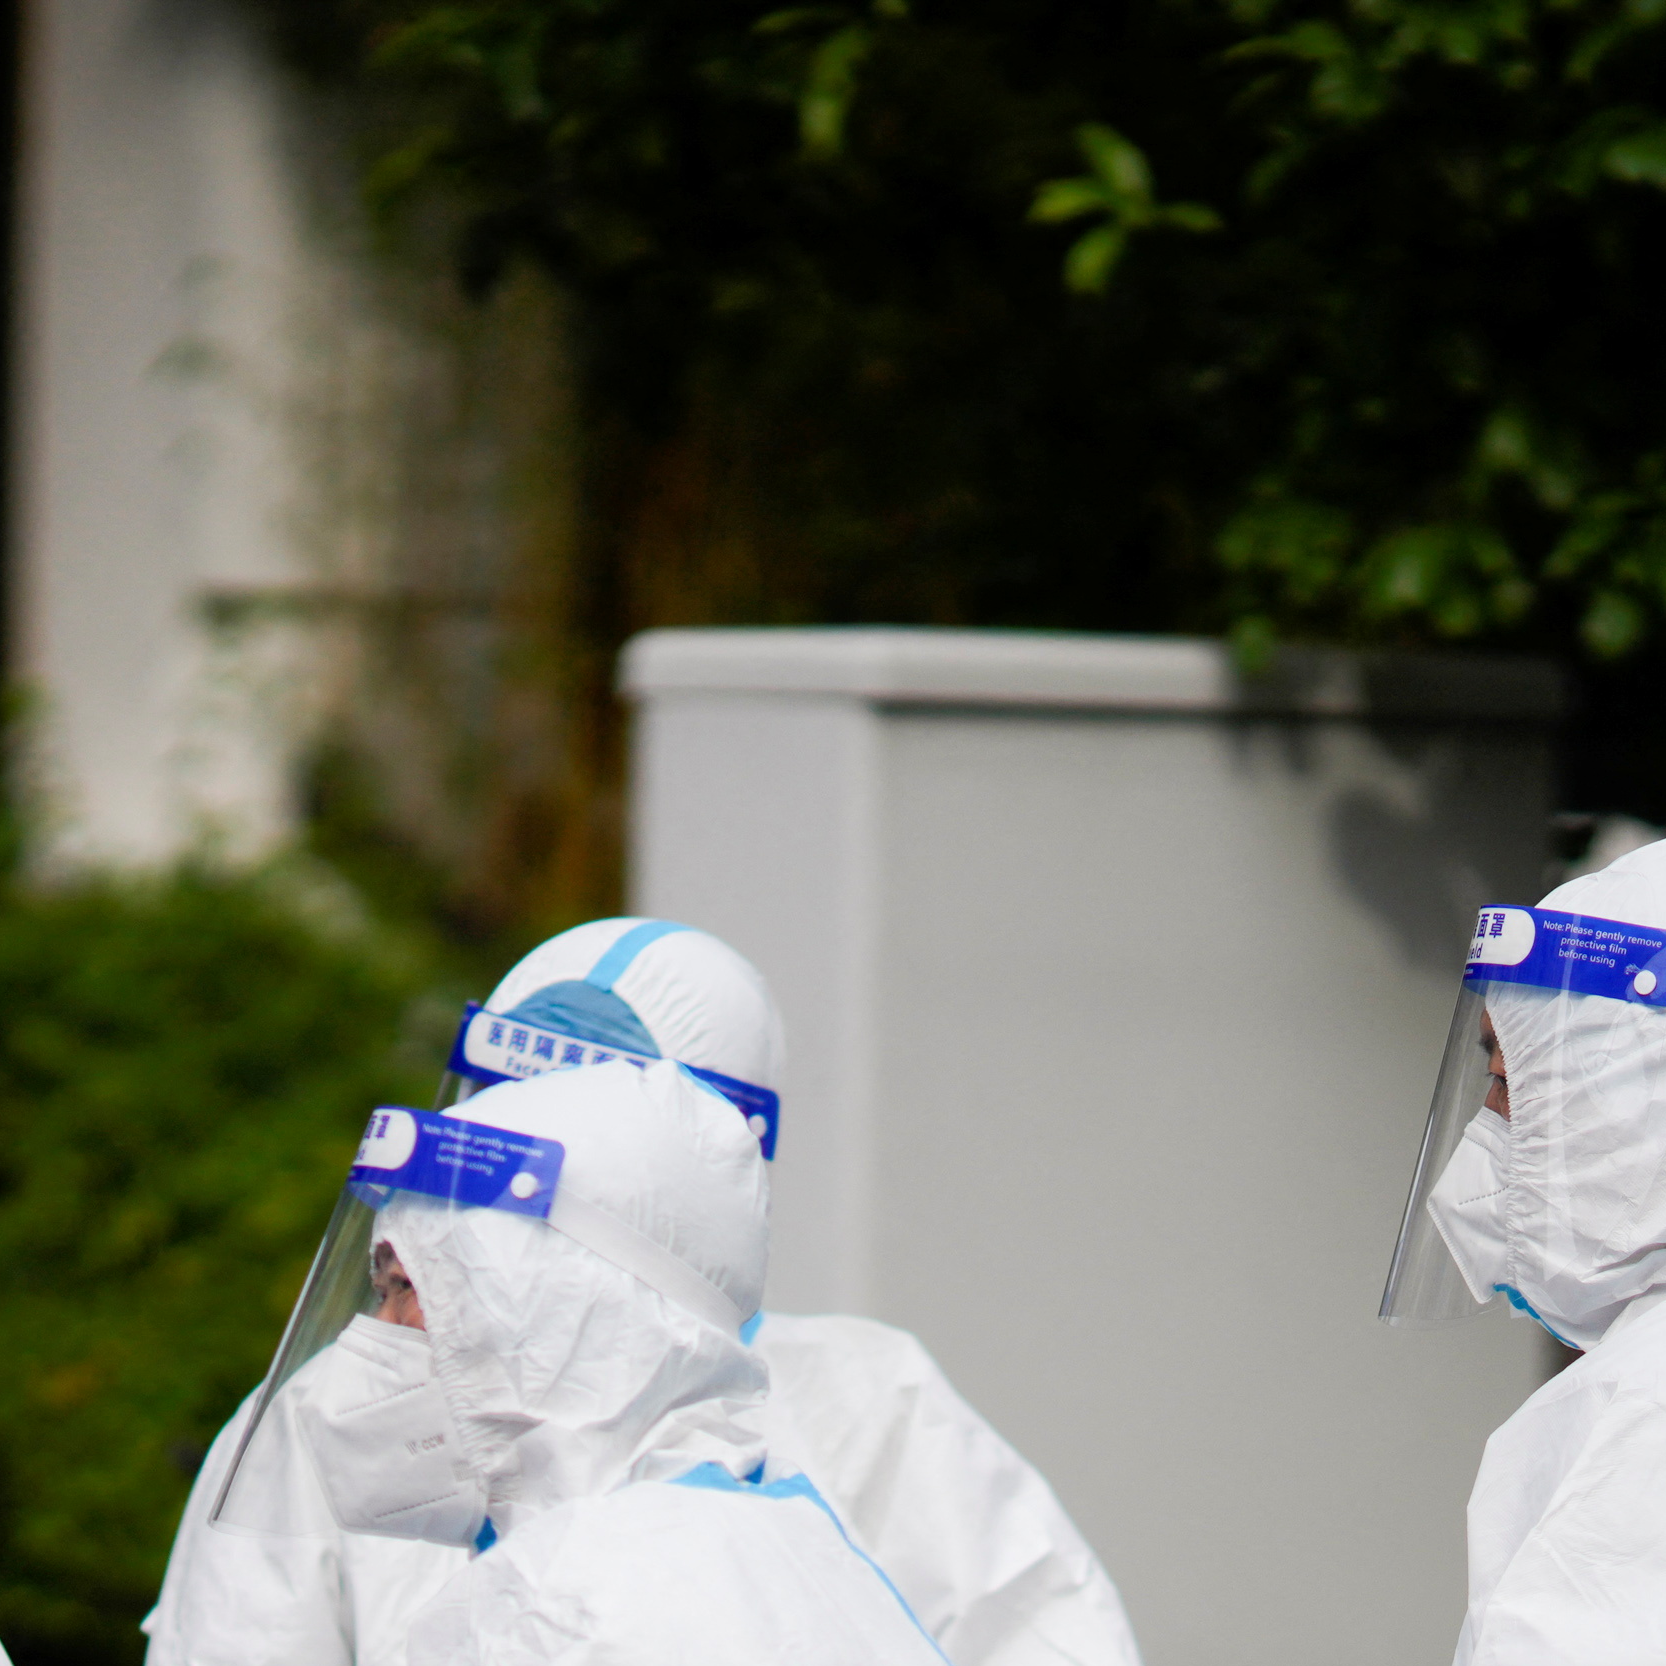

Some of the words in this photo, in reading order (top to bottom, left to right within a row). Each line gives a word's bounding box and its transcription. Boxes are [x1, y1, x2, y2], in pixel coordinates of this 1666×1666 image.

[1473, 913, 1506, 938] 面罩
[1543, 920, 1564, 931] Note:
[1565, 923, 1593, 936] Please
[1595, 930, 1625, 944] gently
[1628, 935, 1663, 948] remove
[1560, 937, 1606, 951] protective
[1609, 943, 1627, 955] film
[1558, 948, 1588, 961] before
[1590, 955, 1616, 968] using
